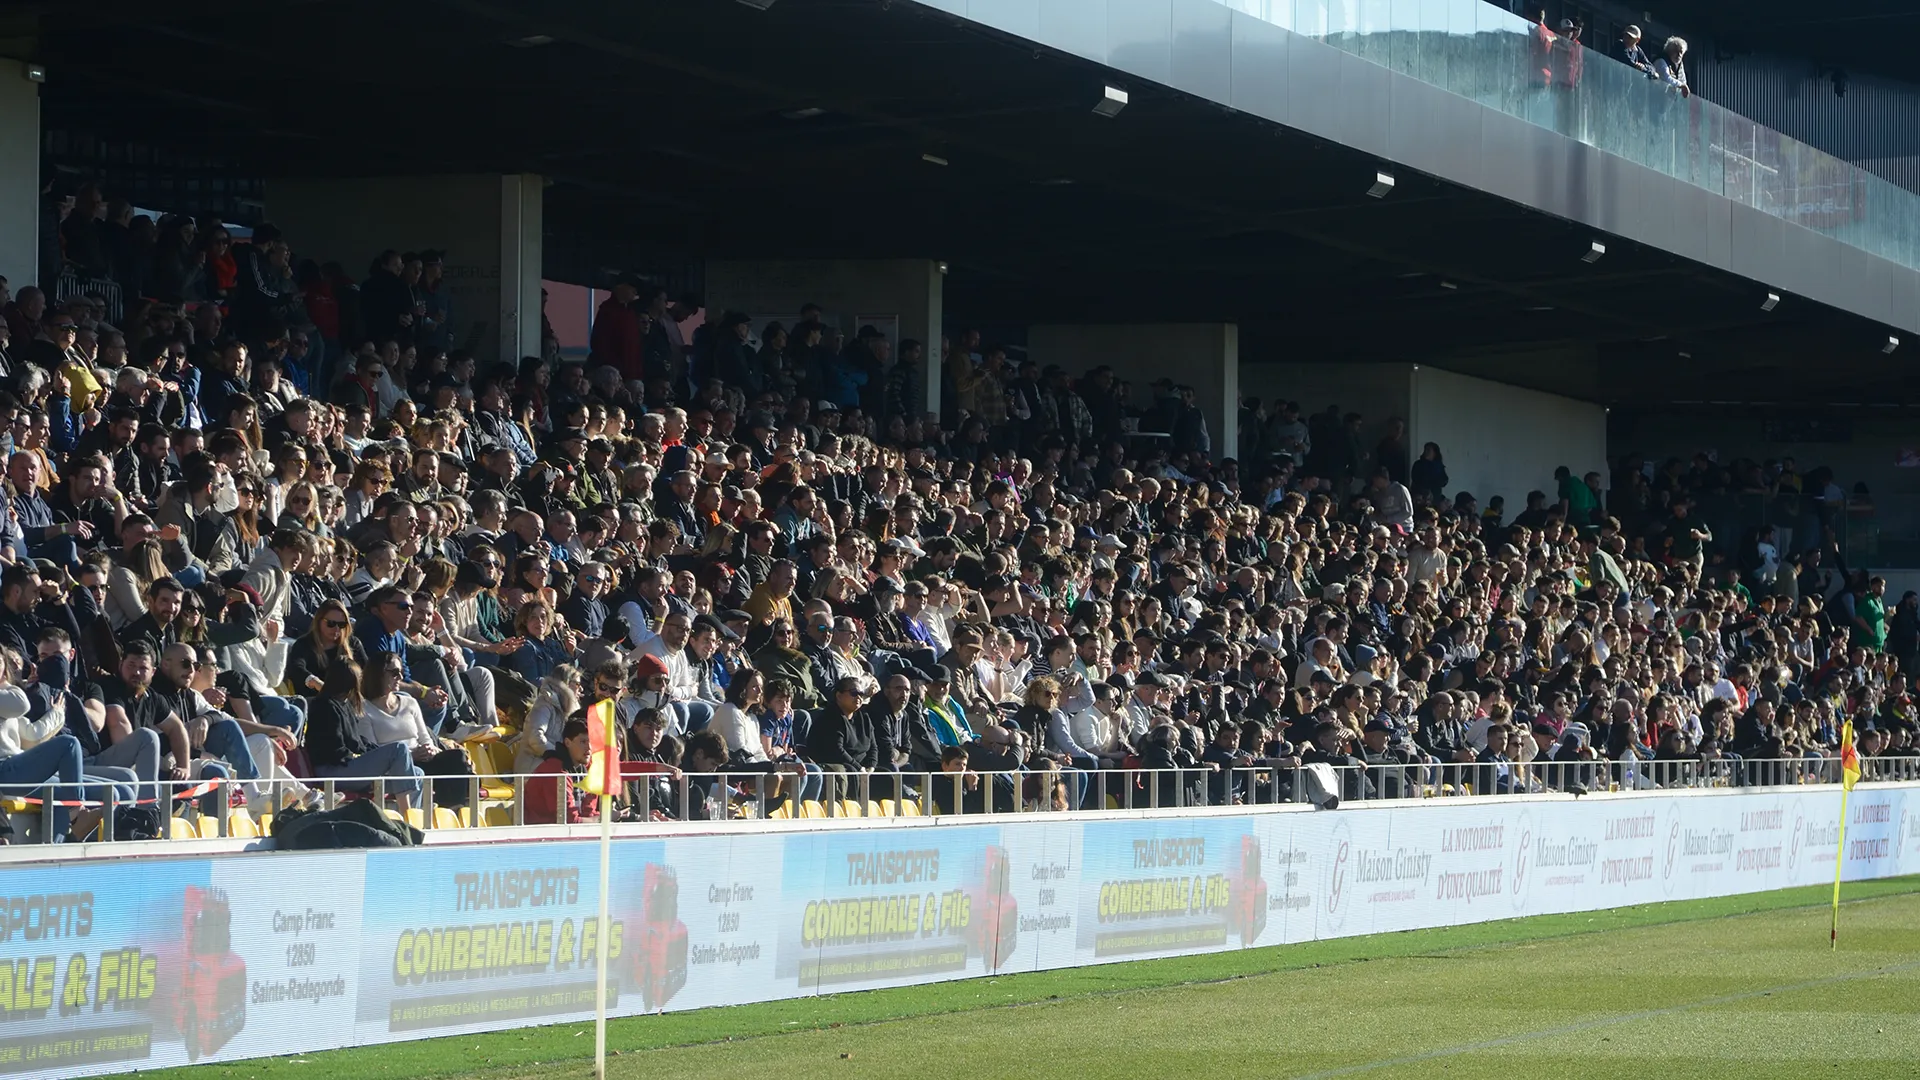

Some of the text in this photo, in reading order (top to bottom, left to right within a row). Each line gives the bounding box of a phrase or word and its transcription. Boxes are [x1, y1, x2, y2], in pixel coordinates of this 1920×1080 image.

[1605, 809, 1656, 841] LA NOTORIÉTÉ
[1740, 812, 1748, 832] LA
[1854, 806, 1861, 824] LA
[1442, 817, 1504, 852] LA NOTORIÉTÉ
[1683, 828, 1708, 856] Maison
[847, 848, 940, 886] TRANSPORTS
[1133, 837, 1205, 869] TRANSPORTS
[1356, 847, 1432, 887] Maison Ginisty
[1535, 836, 1598, 873] Maison Ginisty
[1600, 849, 1654, 887] D'UNE QUALITÉ
[454, 867, 579, 911] TRANSPORTS
[708, 883, 754, 907] Camp Franc
[1098, 873, 1230, 922] COMBEMALE & Fils
[1437, 869, 1466, 900] D'UNE
[1465, 860, 1503, 904] QUALITÉ
[273, 908, 334, 937] Camp Franc
[717, 911, 740, 932] 12850
[802, 889, 971, 947] COMBEMALE & Fils
[286, 943, 315, 967] 12850
[393, 921, 553, 985] COMBEMALE
[555, 917, 577, 971] &
[691, 940, 760, 967] Sainte-Radegonde
[59, 952, 91, 1017] &
[94, 947, 158, 1011] Fils
[252, 972, 345, 1004] Sainte-Radegonde
